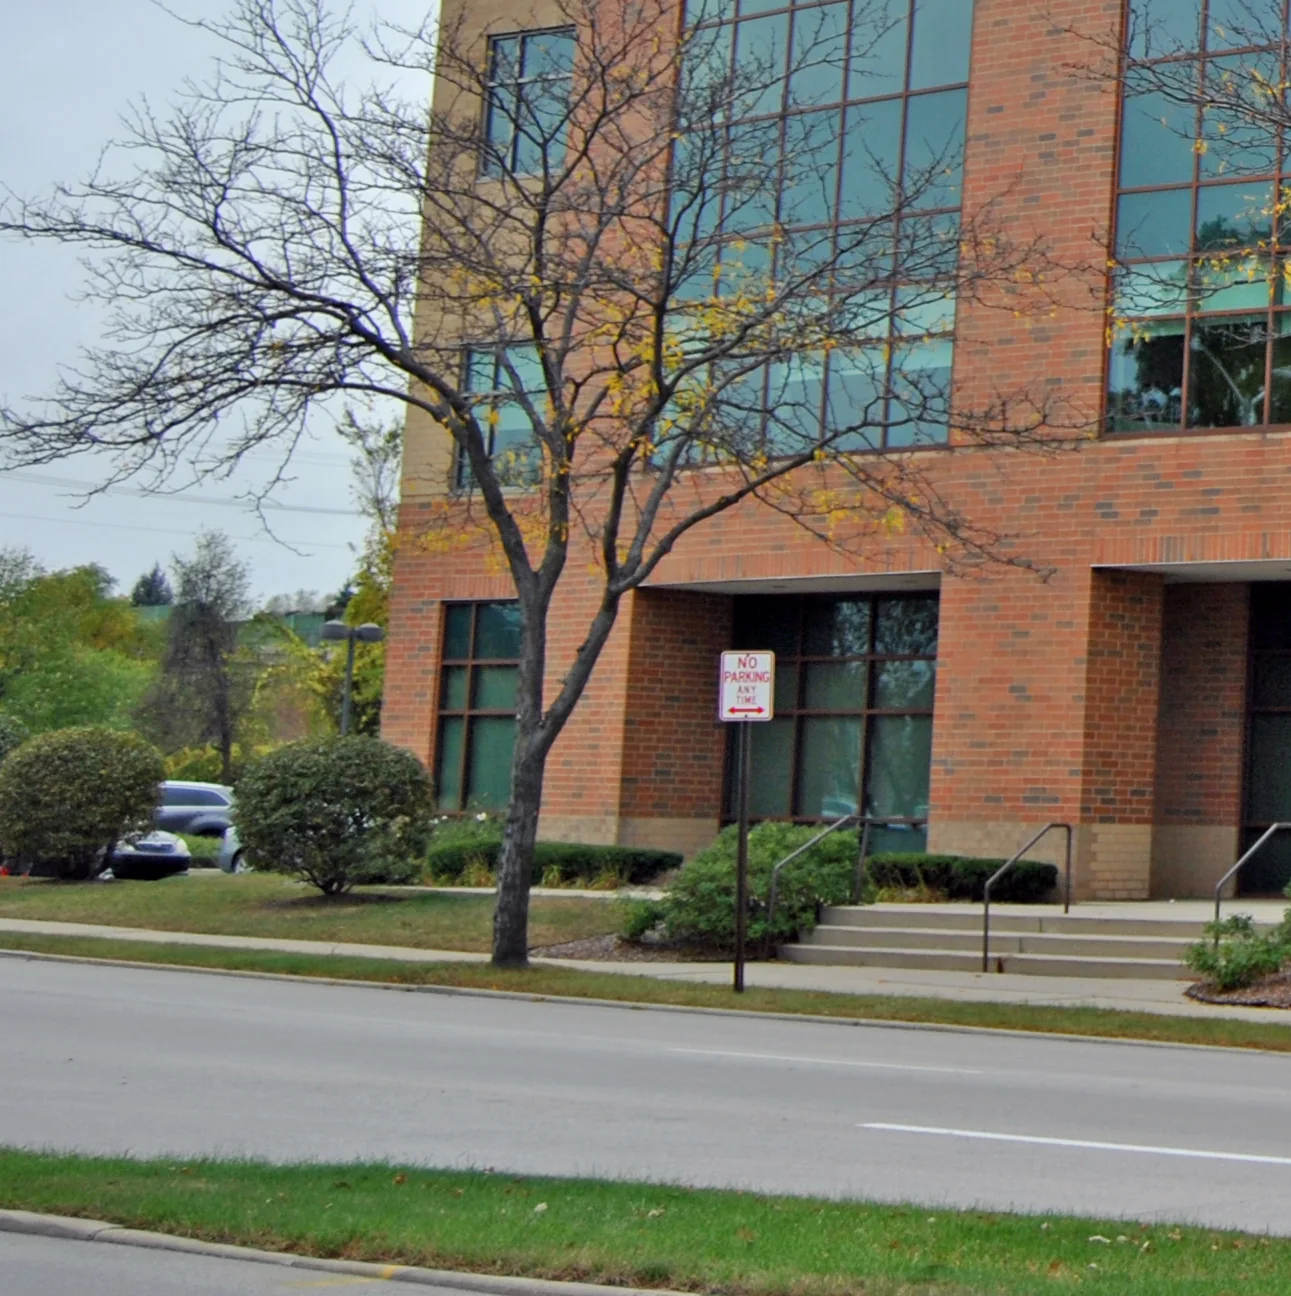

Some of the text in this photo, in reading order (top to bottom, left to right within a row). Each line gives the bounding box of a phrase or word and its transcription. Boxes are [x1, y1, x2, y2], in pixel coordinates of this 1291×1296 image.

[738, 657, 757, 669] NO
[724, 671, 770, 683] PARKING
[738, 686, 756, 694] ANY
[737, 696, 757, 705] TIME
